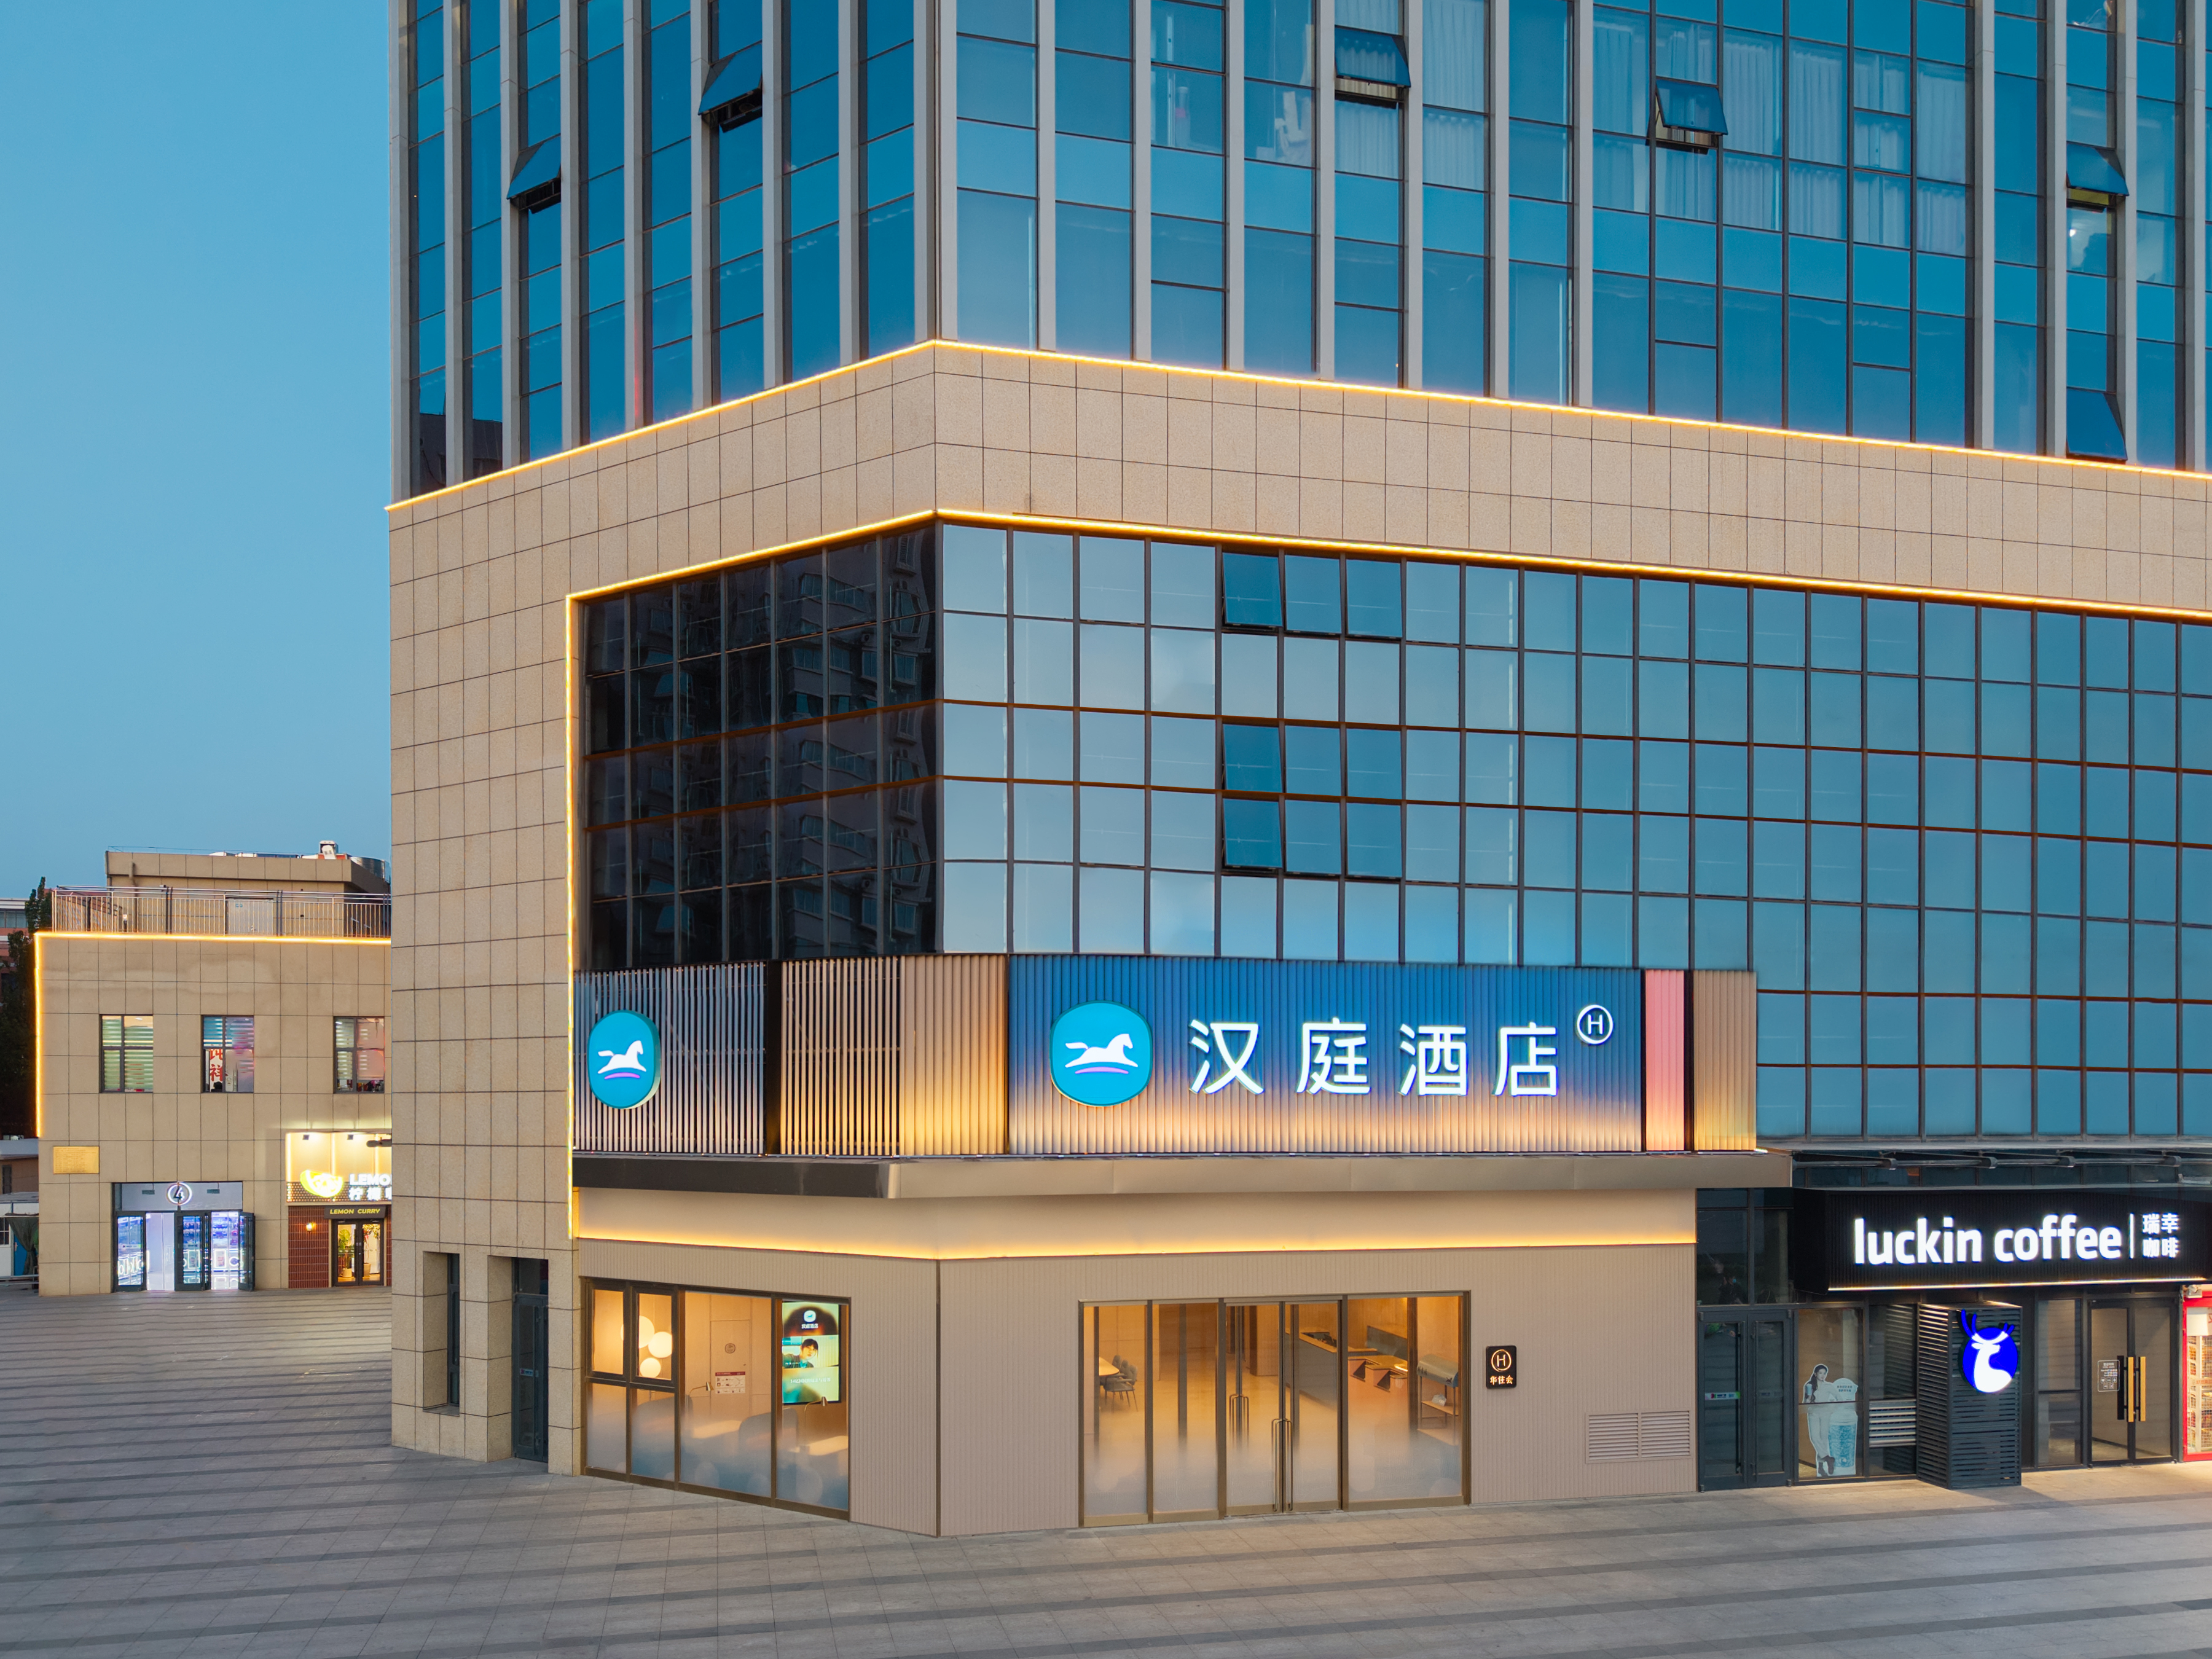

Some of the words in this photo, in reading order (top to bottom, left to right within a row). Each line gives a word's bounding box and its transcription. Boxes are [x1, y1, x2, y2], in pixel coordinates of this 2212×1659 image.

[1190, 1018, 1558, 1096] 汉庭酒店
[350, 1173, 391, 1186] LEMO
[2142, 1212, 2179, 1234] 瑞幸
[1854, 1217, 1982, 1265] luckin
[1994, 1214, 2122, 1263] coffee
[2142, 1236, 2179, 1259] 咖啡
[1490, 1375, 1513, 1385] 华住会
